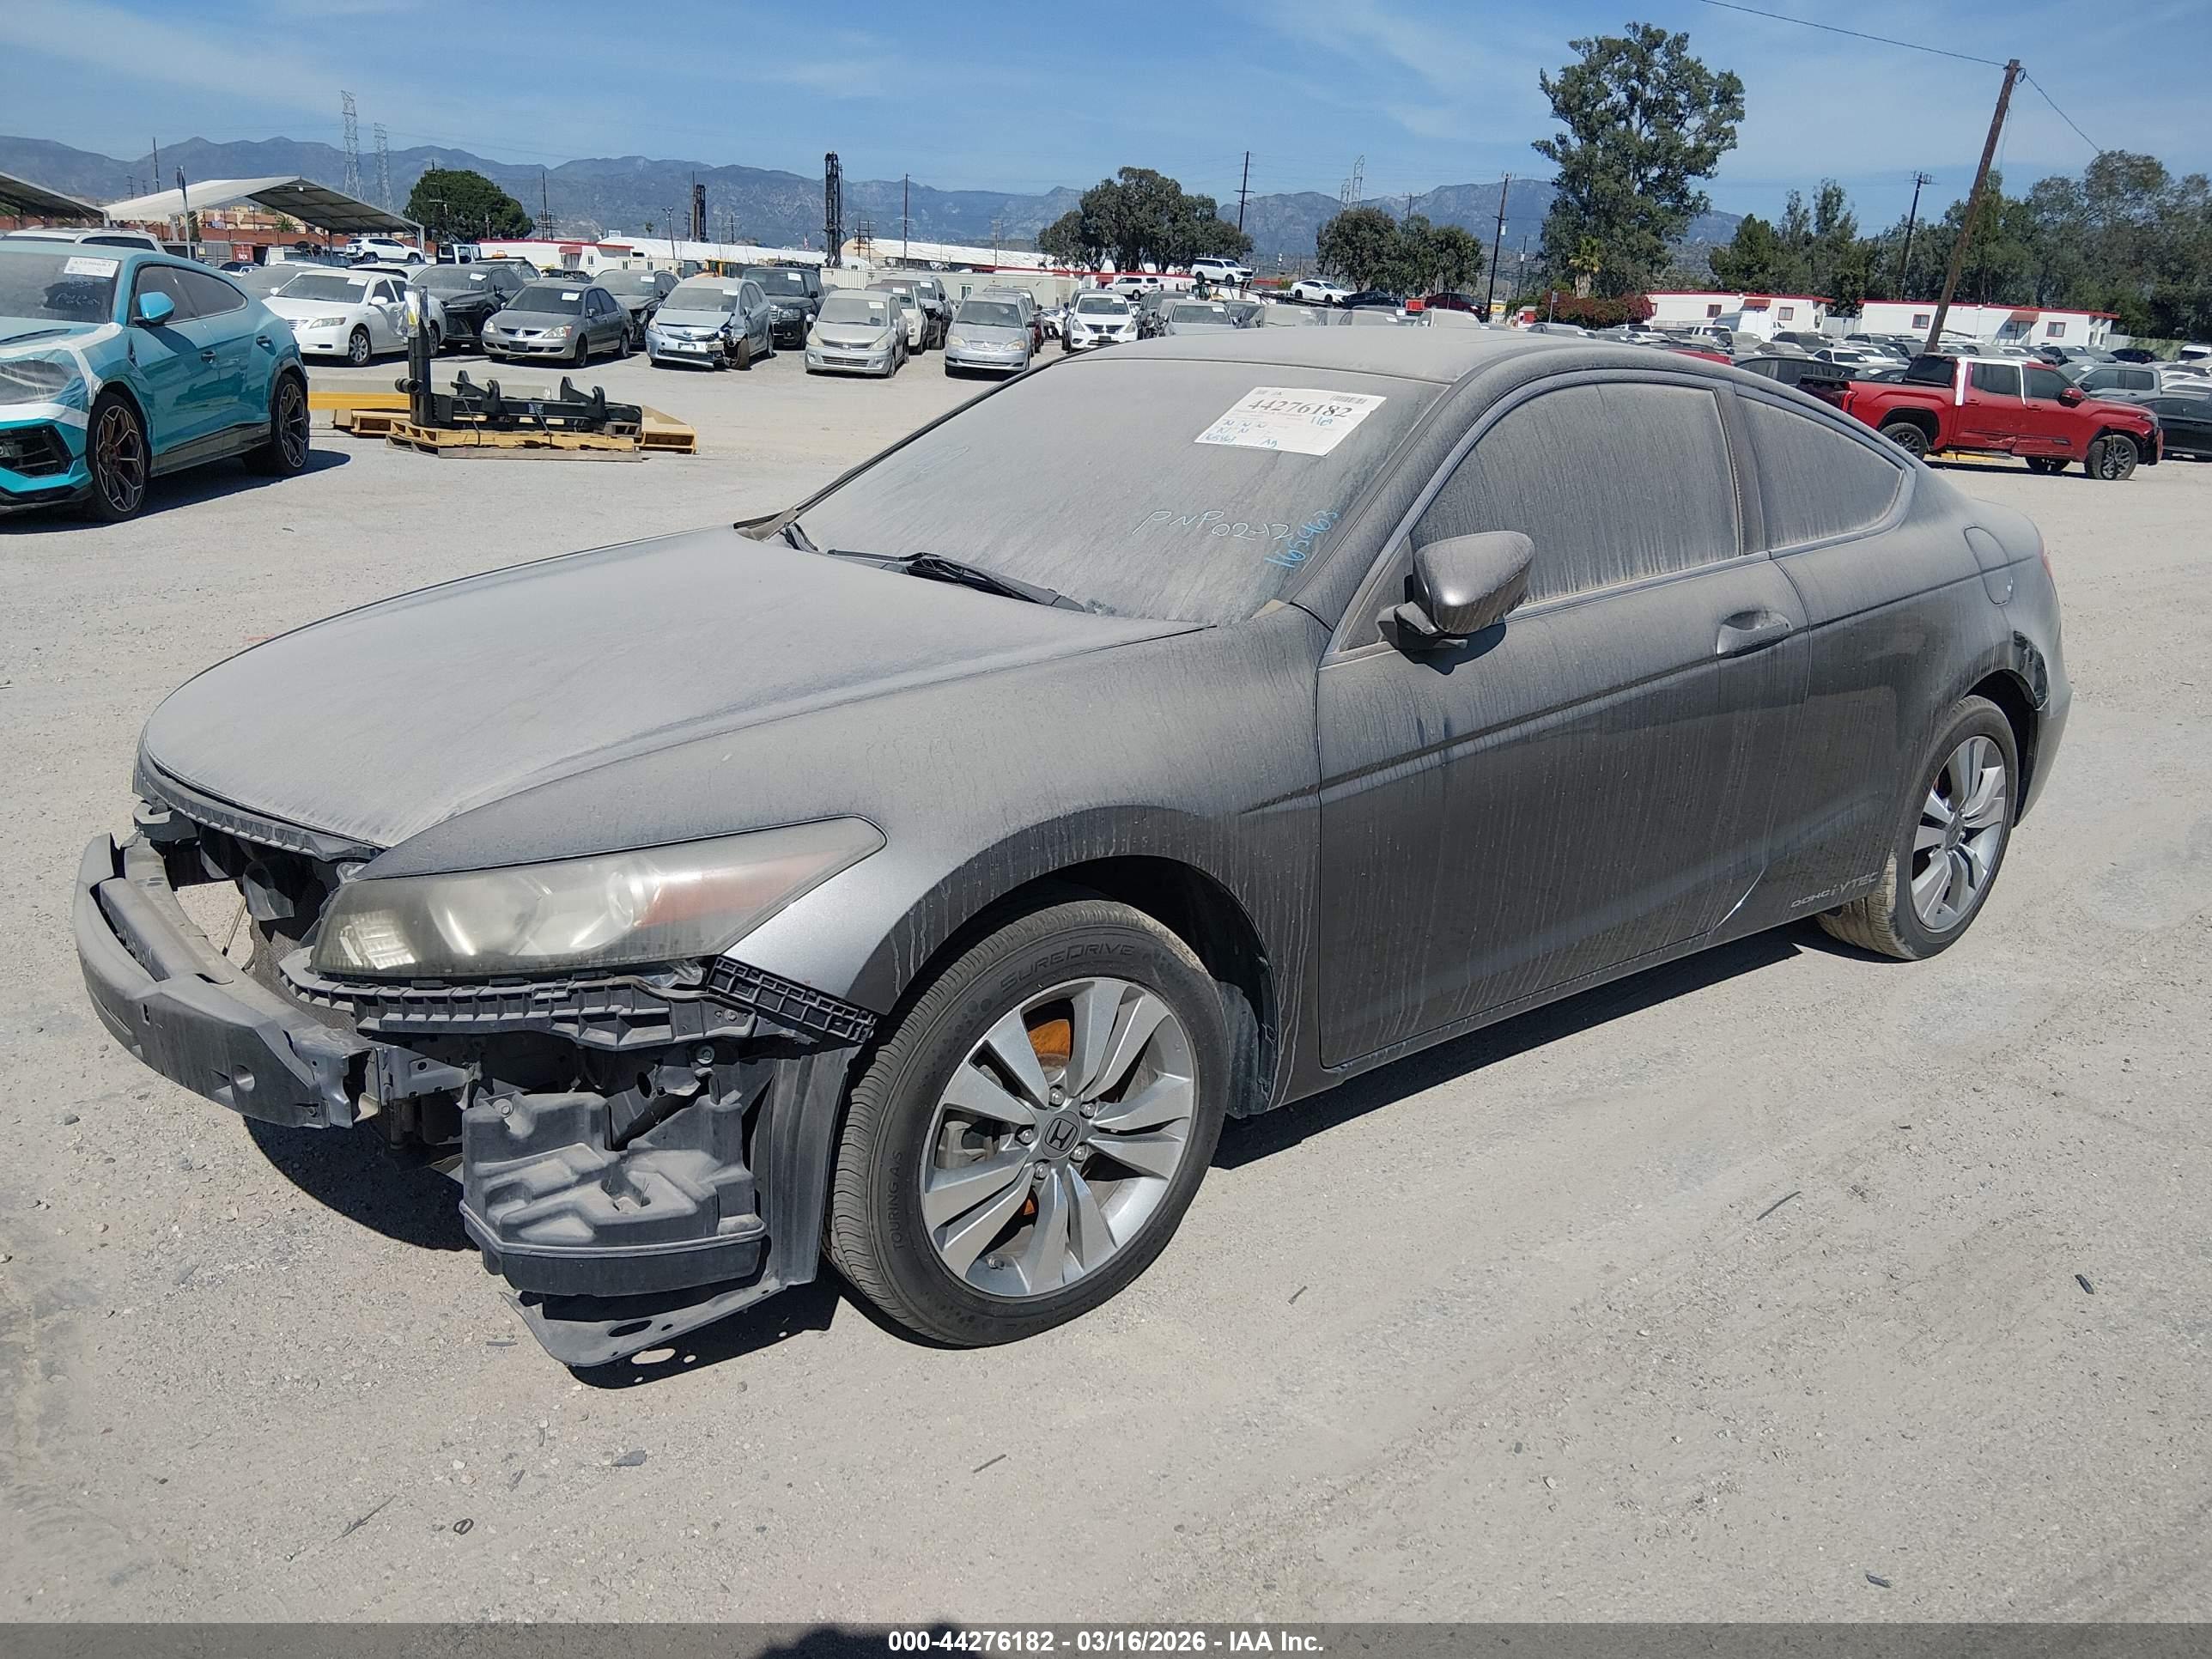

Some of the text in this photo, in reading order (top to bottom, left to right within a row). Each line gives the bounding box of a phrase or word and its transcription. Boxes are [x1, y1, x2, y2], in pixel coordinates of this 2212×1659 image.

[1248, 398, 1353, 418] 44276182
[1132, 509, 1224, 536] PNP
[886, 1149, 905, 1251] TOURING A/S
